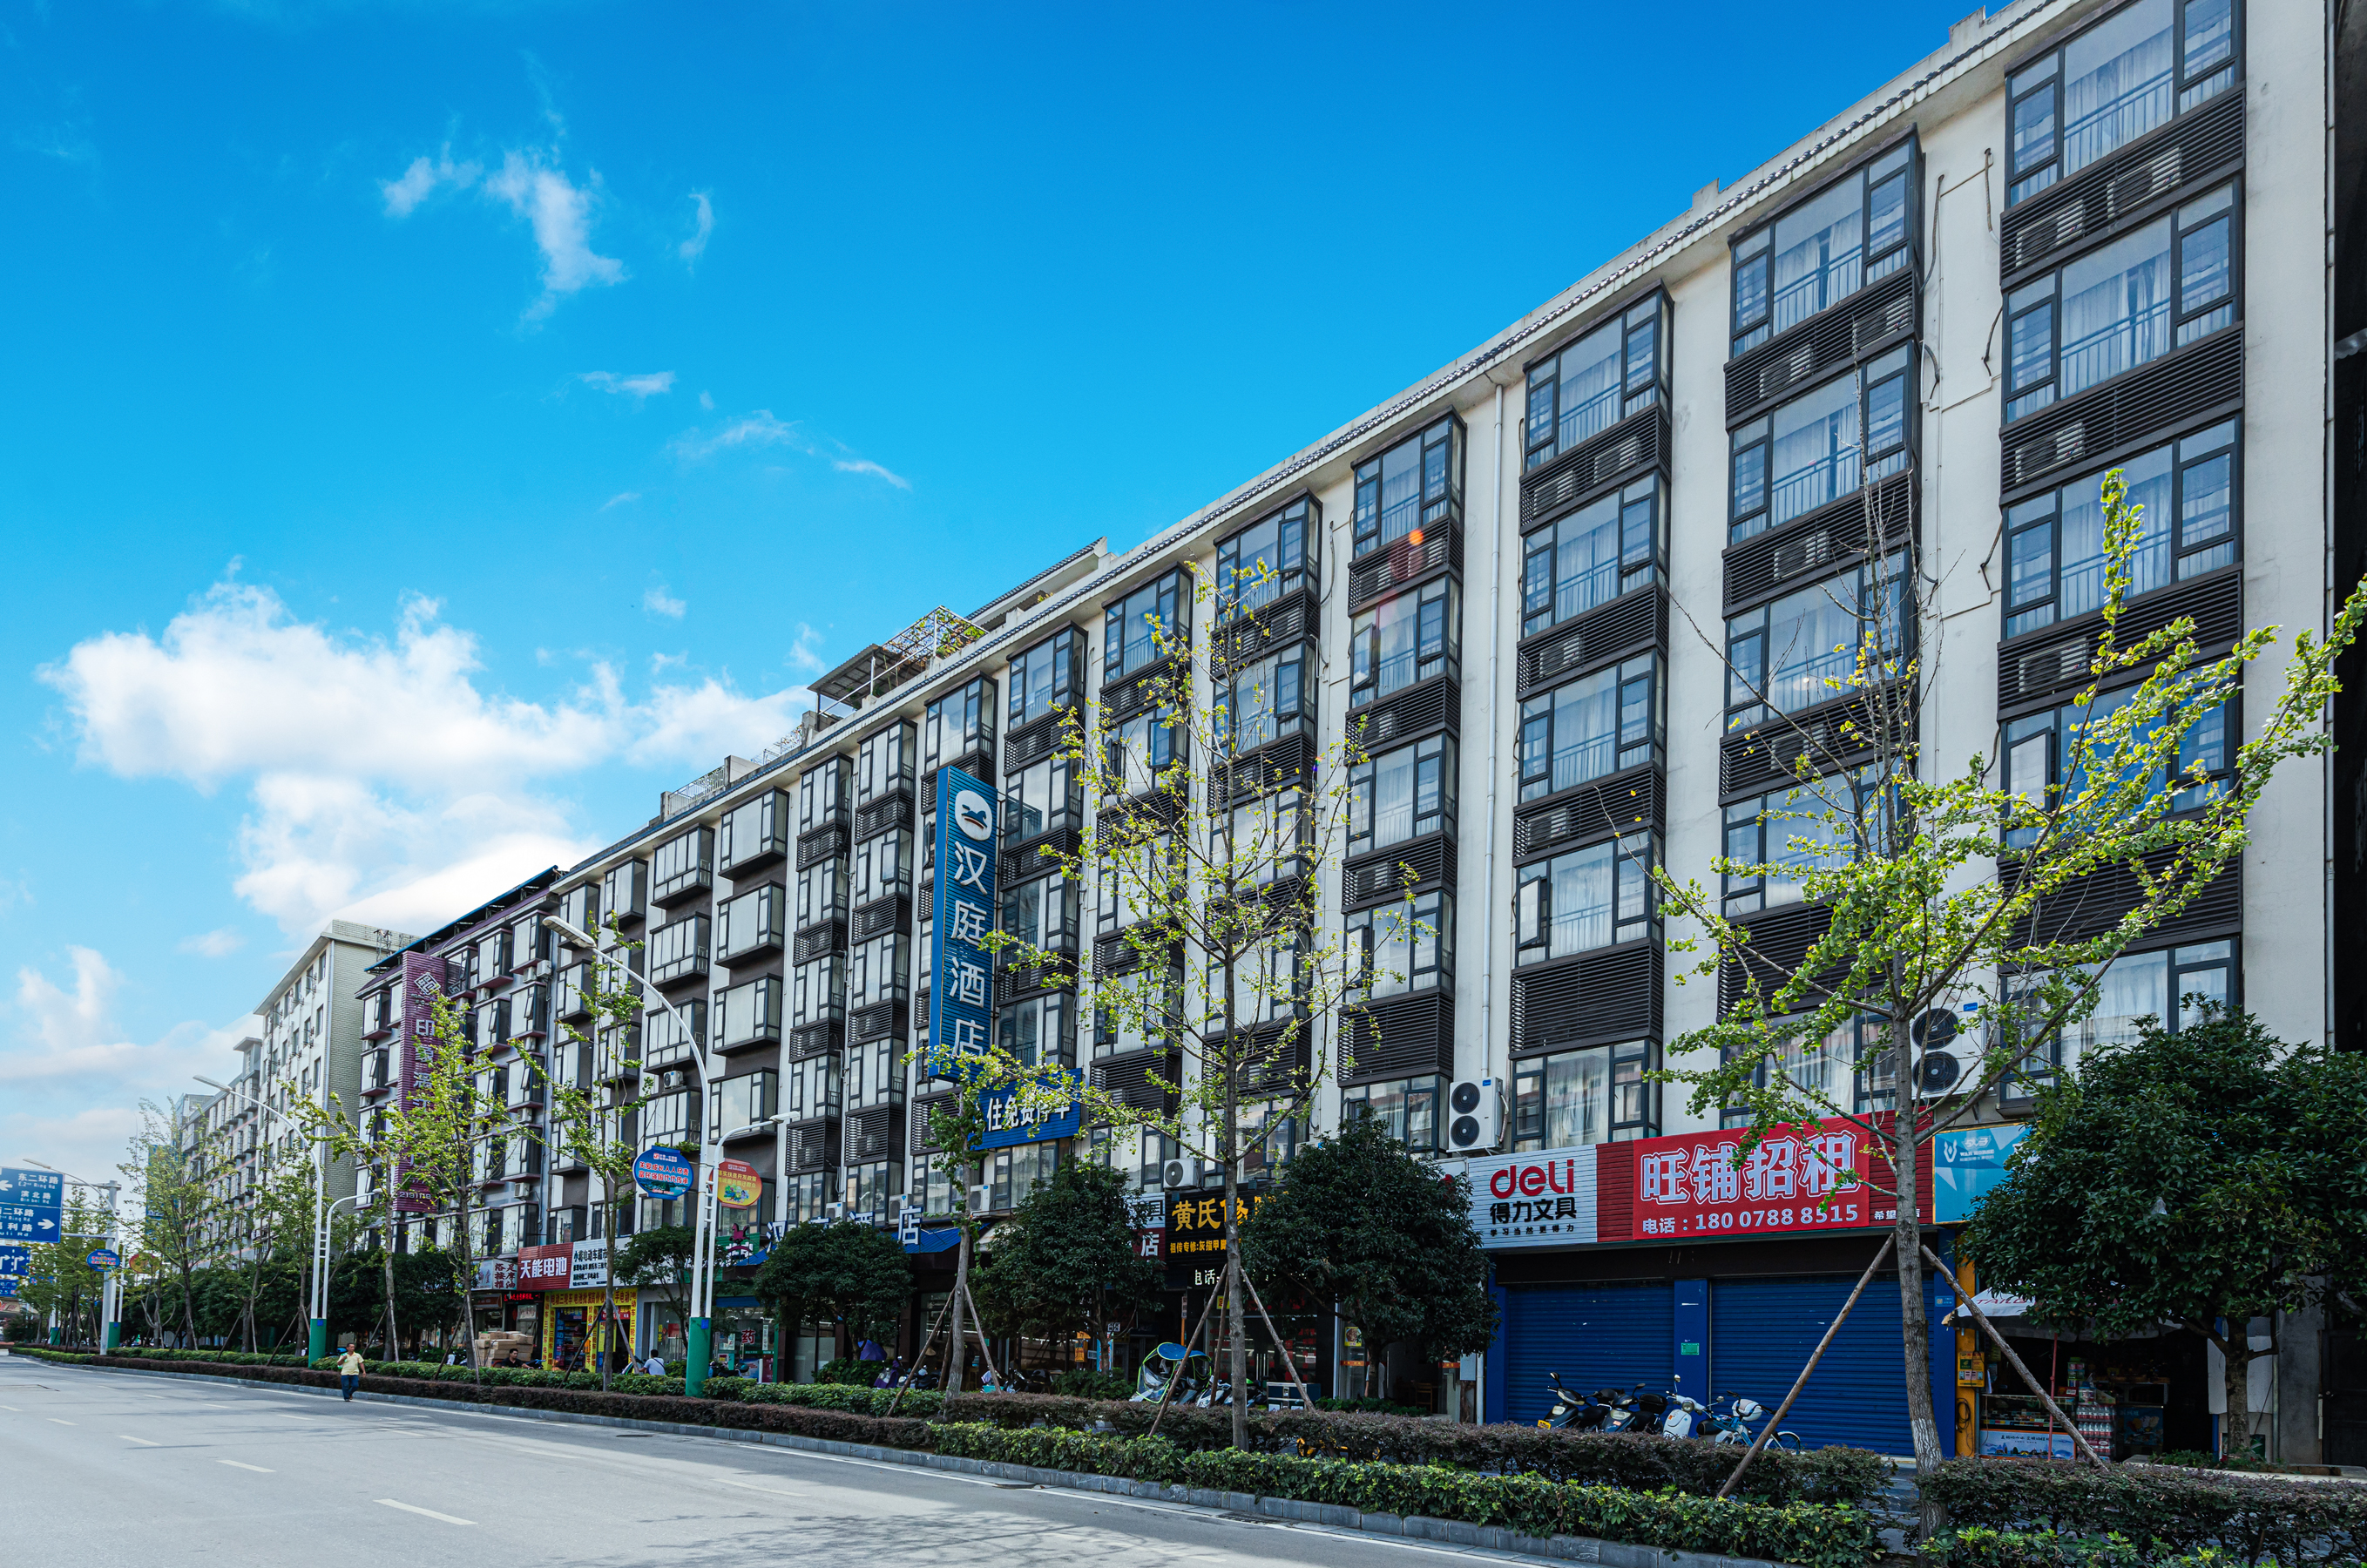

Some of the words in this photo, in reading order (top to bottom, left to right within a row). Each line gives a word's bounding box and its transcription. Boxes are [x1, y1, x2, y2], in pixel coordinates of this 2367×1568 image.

[949, 841, 988, 1059] 汉庭酒店
[17, 1173, 58, 1185] 东二环路
[1490, 1159, 1574, 1200] deli
[1640, 1129, 1861, 1205] 旺铺招租
[1172, 1192, 1276, 1232] 黄氏修
[1489, 1197, 1577, 1225] 得力文具
[1695, 1212, 1733, 1230] 180
[1739, 1208, 1795, 1228] 0788
[1800, 1204, 1858, 1224] 8515
[1874, 1208, 1921, 1220] 希望
[1490, 1224, 1574, 1237] 学习当然更得力
[520, 1256, 567, 1279] 天能电池
[741, 1329, 755, 1344] 药
